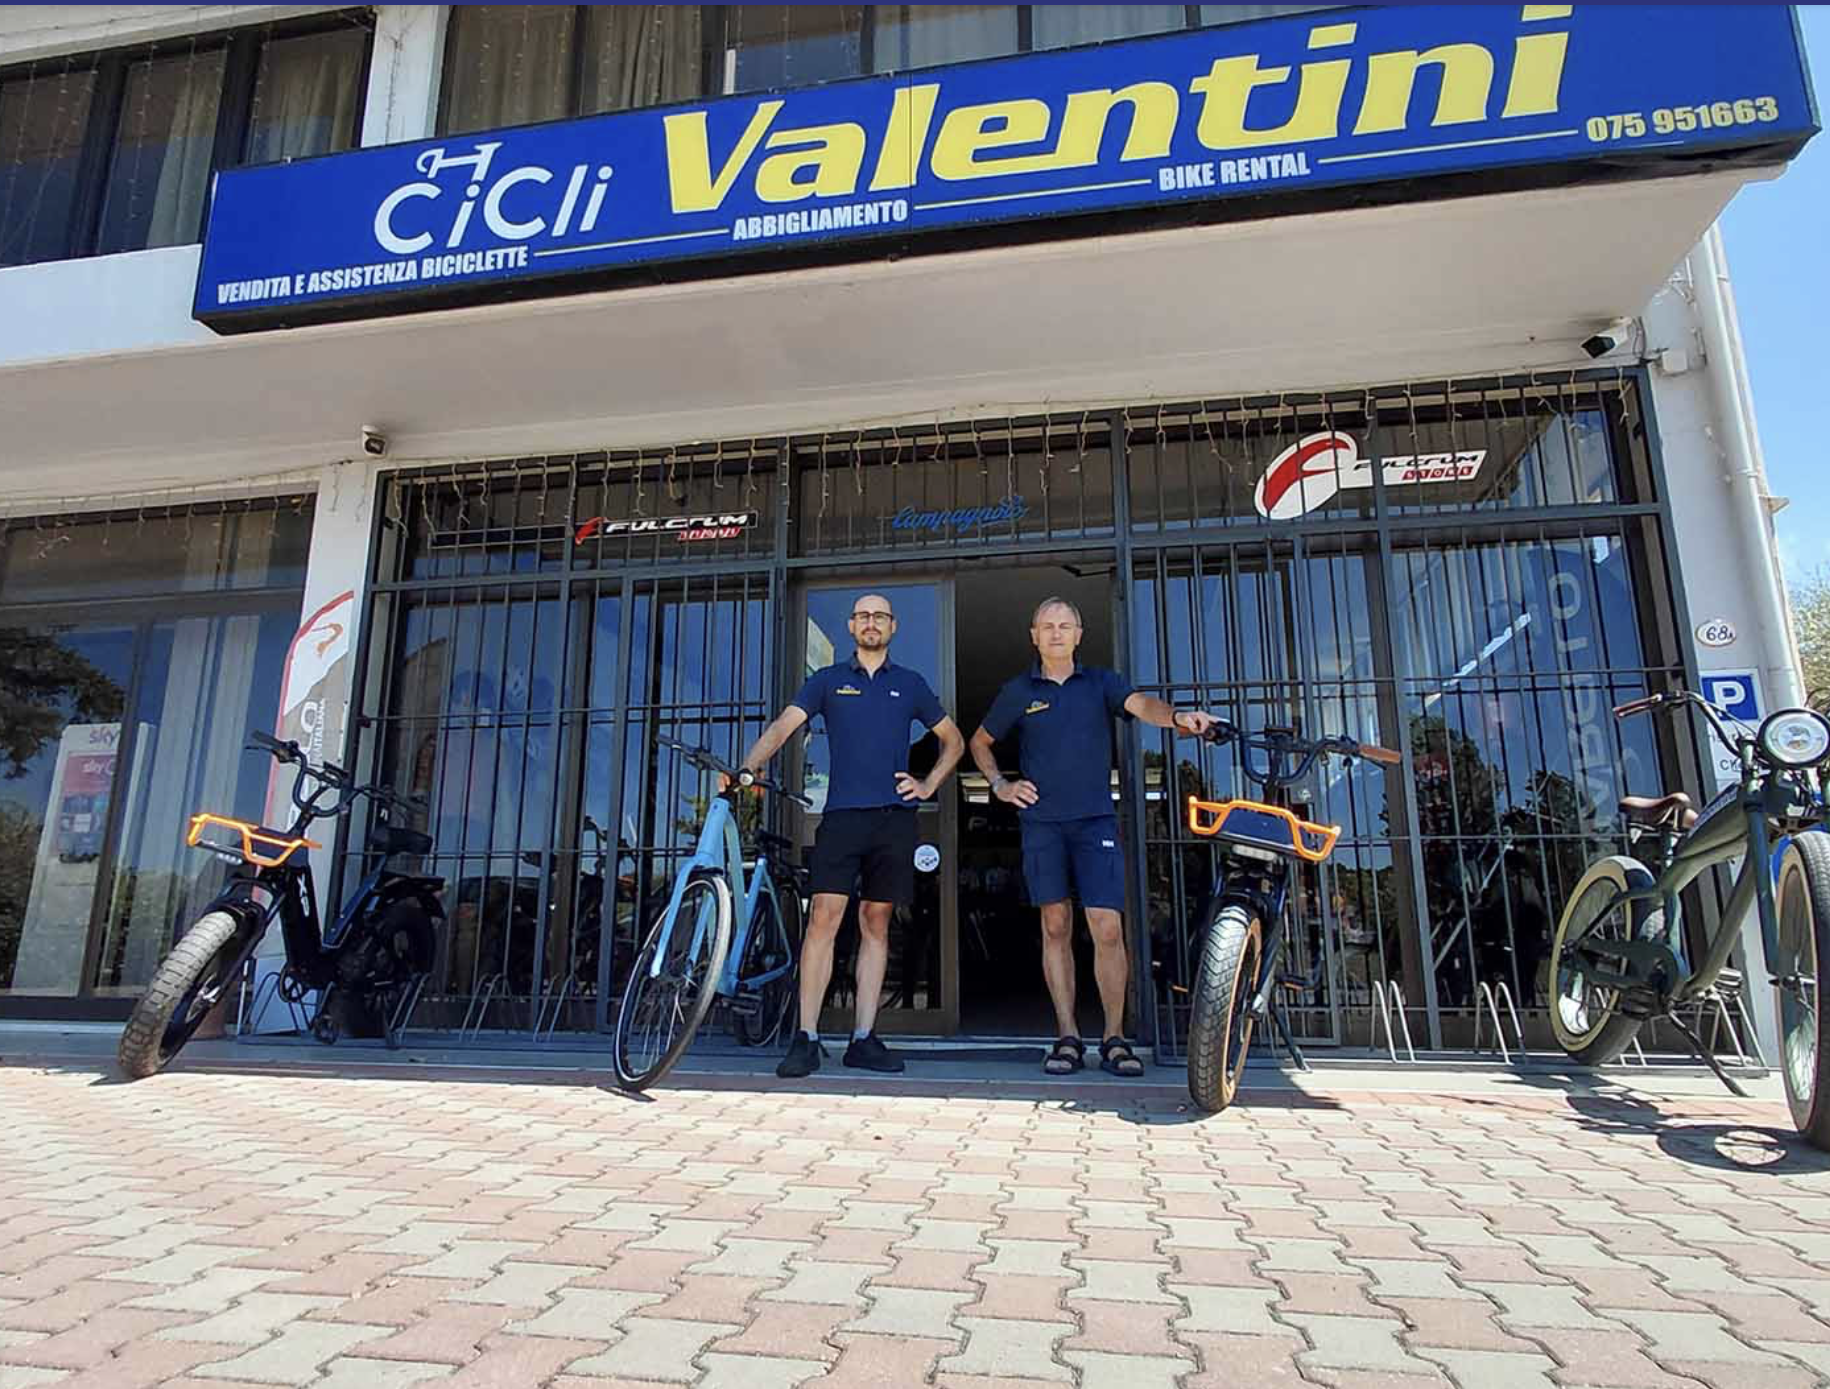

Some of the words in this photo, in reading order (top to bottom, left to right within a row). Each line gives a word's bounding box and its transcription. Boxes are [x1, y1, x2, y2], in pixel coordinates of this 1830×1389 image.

[664, 4, 1573, 214] Valentini
[1586, 113, 1646, 142] 075
[1652, 96, 1779, 134] 951663
[1159, 163, 1215, 191] BIKE
[1220, 152, 1311, 184] RENTAL
[733, 199, 908, 241] ABBIGLIAMENTO
[218, 276, 291, 304] VENDITA
[294, 274, 305, 295] E
[307, 260, 418, 293] ASSISTENZA
[421, 245, 528, 279] BICICLETTE
[1712, 681, 1746, 717] P
